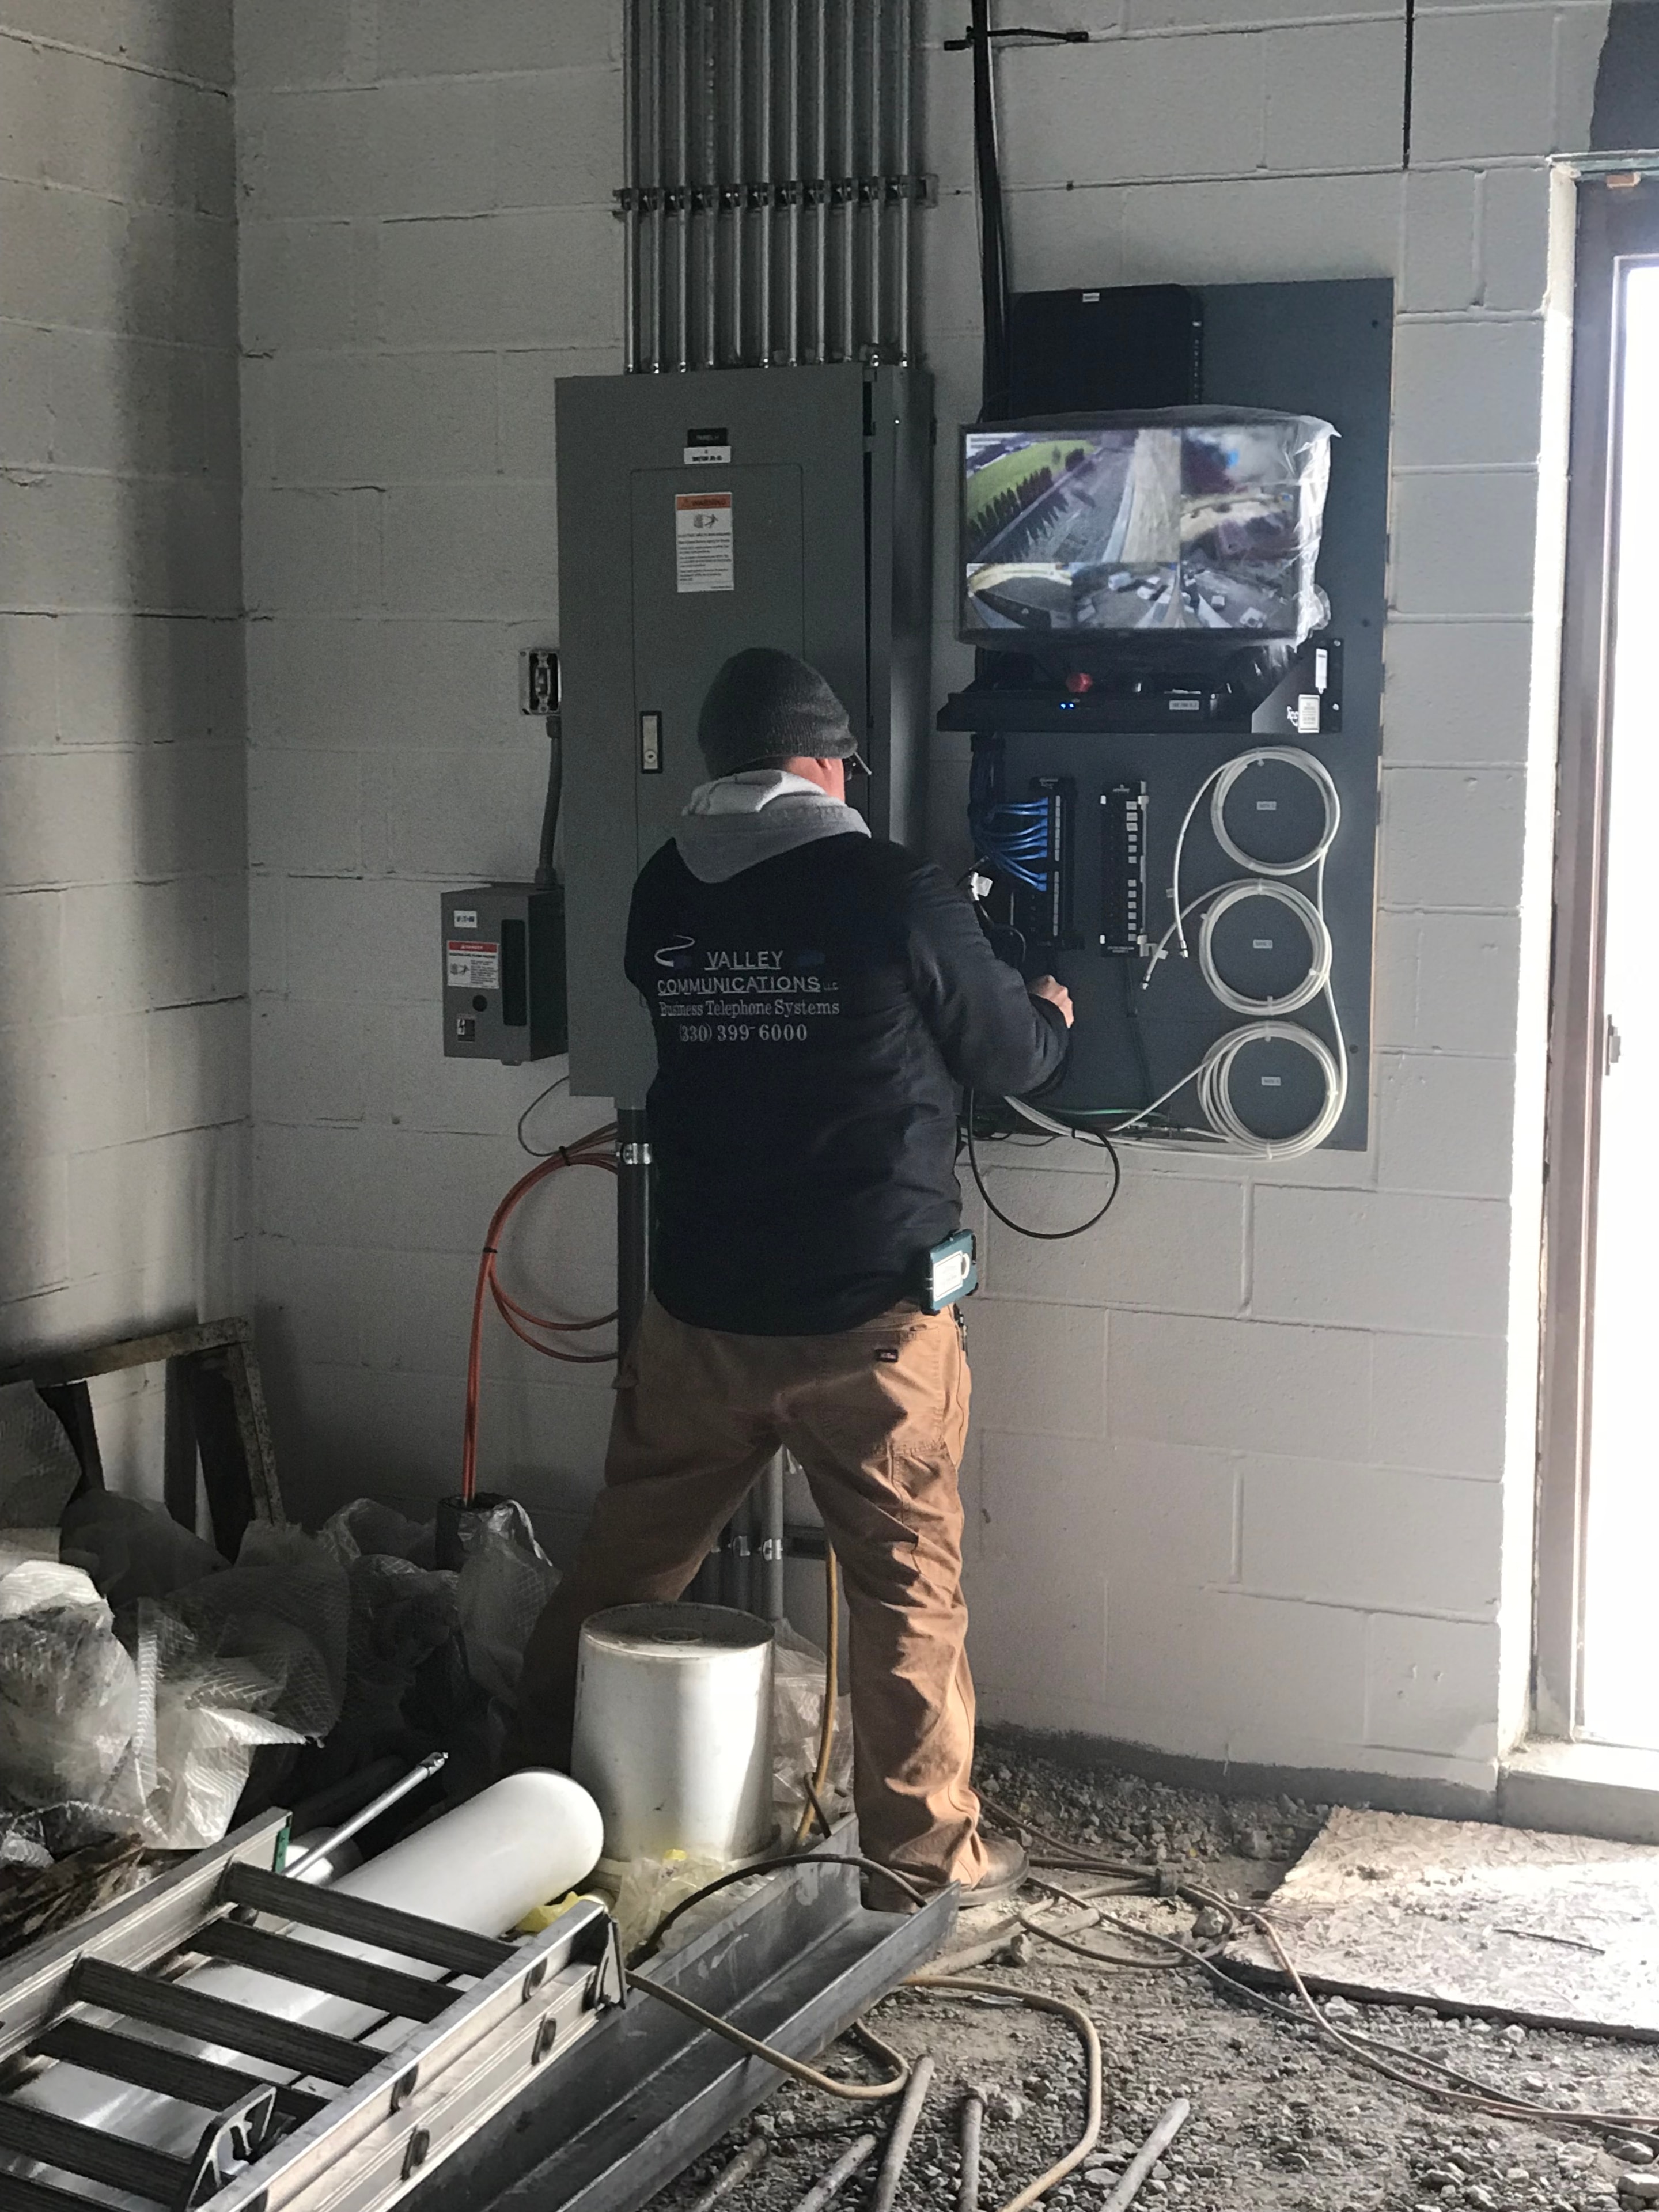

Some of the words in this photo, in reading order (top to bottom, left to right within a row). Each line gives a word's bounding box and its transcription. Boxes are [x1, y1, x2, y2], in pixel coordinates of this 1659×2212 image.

[706, 951, 783, 968] VALLEY
[658, 977, 820, 994] COMMUNICATIONS
[659, 1002, 703, 1016] Business
[705, 1000, 771, 1018] Telephone
[775, 999, 839, 1017] Systems
[679, 1024, 712, 1041] (330)
[717, 1024, 807, 1041] 399-6000
